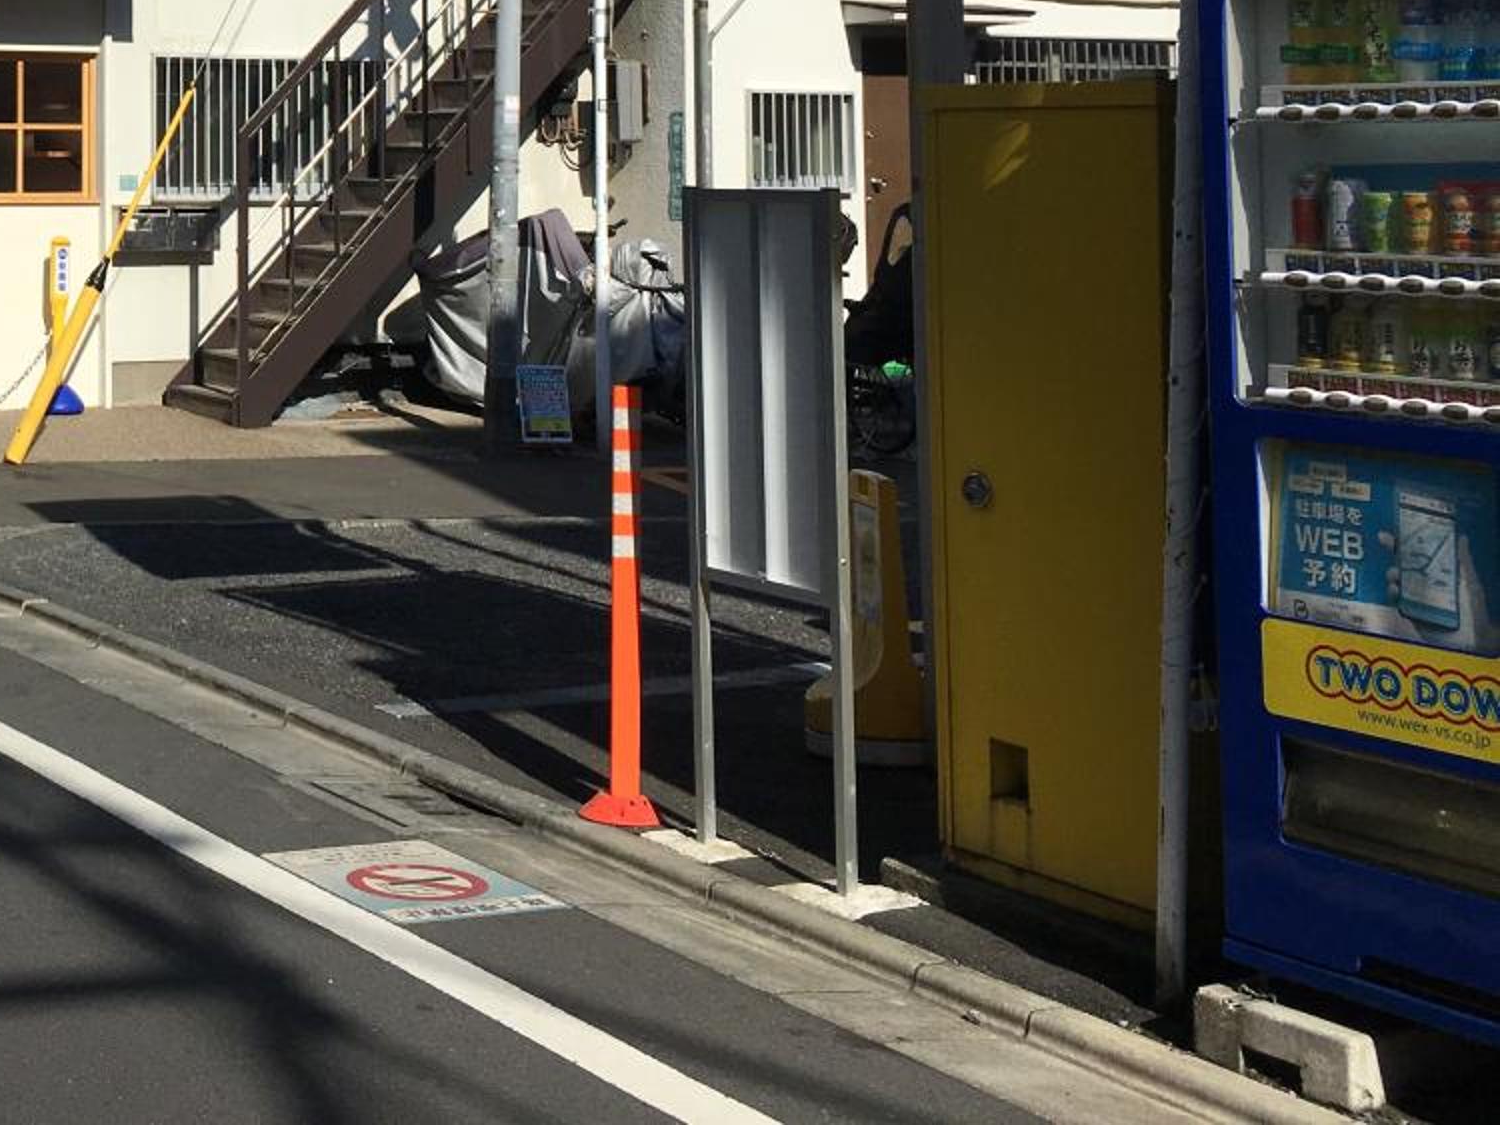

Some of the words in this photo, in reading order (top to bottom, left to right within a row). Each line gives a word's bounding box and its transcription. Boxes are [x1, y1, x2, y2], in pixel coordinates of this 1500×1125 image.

[1296, 524, 1365, 560] WEB
[1303, 560, 1357, 594] 予約
[1314, 655, 1402, 701] TWO
[1357, 709, 1491, 750] www.wex-vs.co.jp
